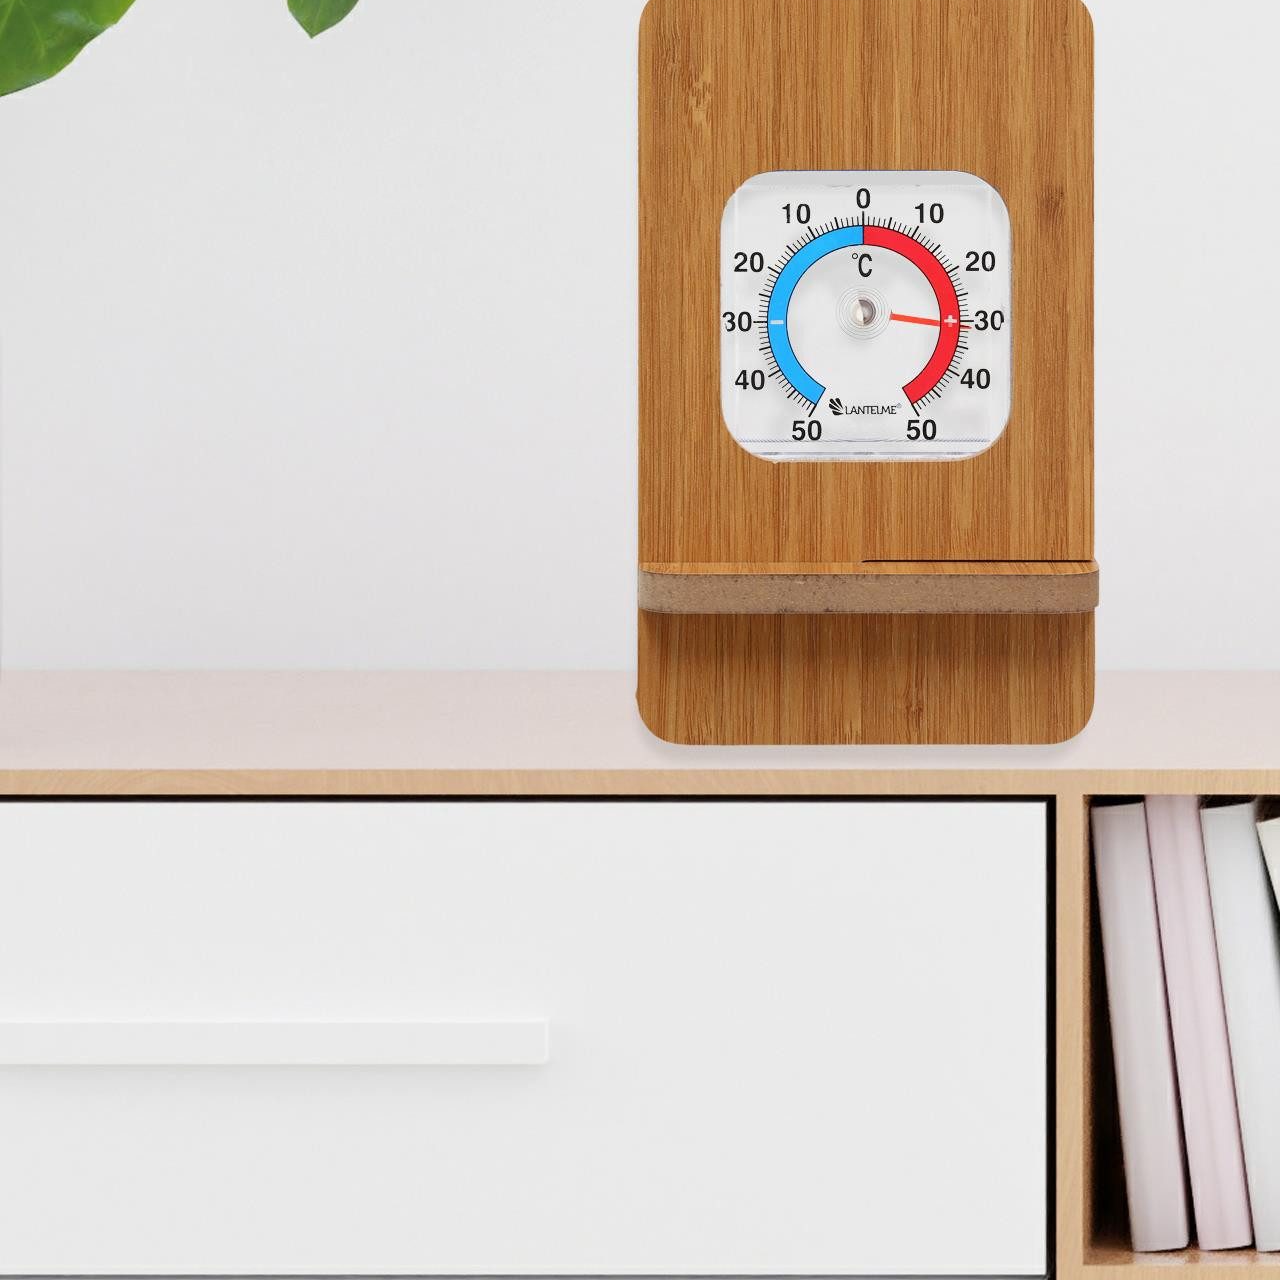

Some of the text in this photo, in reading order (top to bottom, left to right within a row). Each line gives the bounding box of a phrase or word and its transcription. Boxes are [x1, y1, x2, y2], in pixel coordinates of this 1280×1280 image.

[857, 188, 870, 209] 0
[782, 204, 810, 224] 10
[915, 203, 944, 223] 10
[734, 252, 764, 272] 20
[852, 253, 872, 277] °C
[966, 251, 995, 272] 20
[723, 312, 752, 332] 30
[975, 310, 1004, 331] 30
[735, 370, 765, 390] 40
[960, 369, 990, 389] 40
[791, 420, 822, 442] 50
[907, 419, 937, 441] 50
